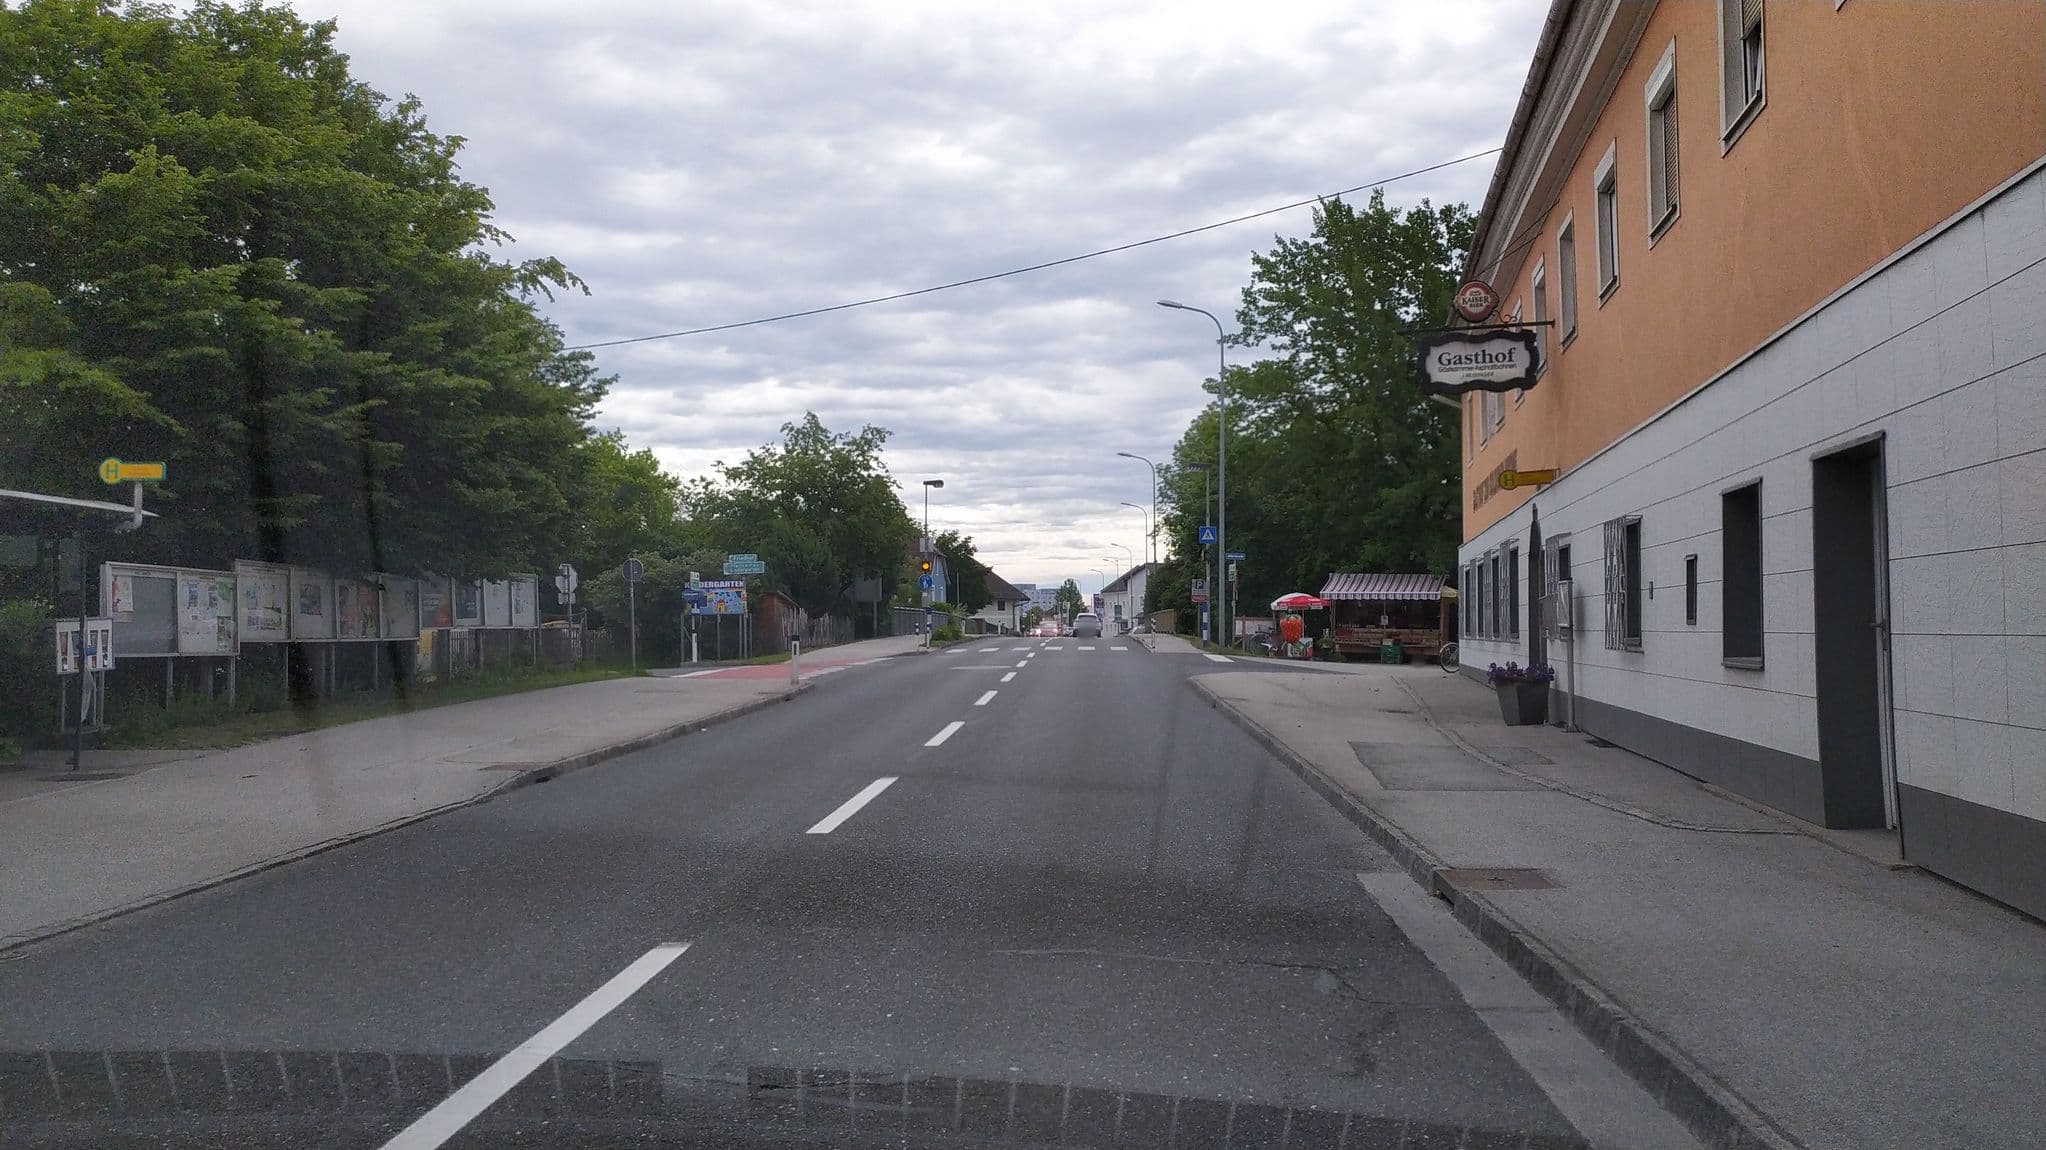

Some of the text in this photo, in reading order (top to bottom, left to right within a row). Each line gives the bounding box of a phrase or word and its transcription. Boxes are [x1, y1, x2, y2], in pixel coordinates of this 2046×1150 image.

[1462, 295, 1490, 305] KAISER
[1438, 347, 1516, 366] Gasthof
[106, 463, 118, 479] H
[1503, 473, 1514, 487] H
[684, 580, 744, 589] KDERGARTEN
